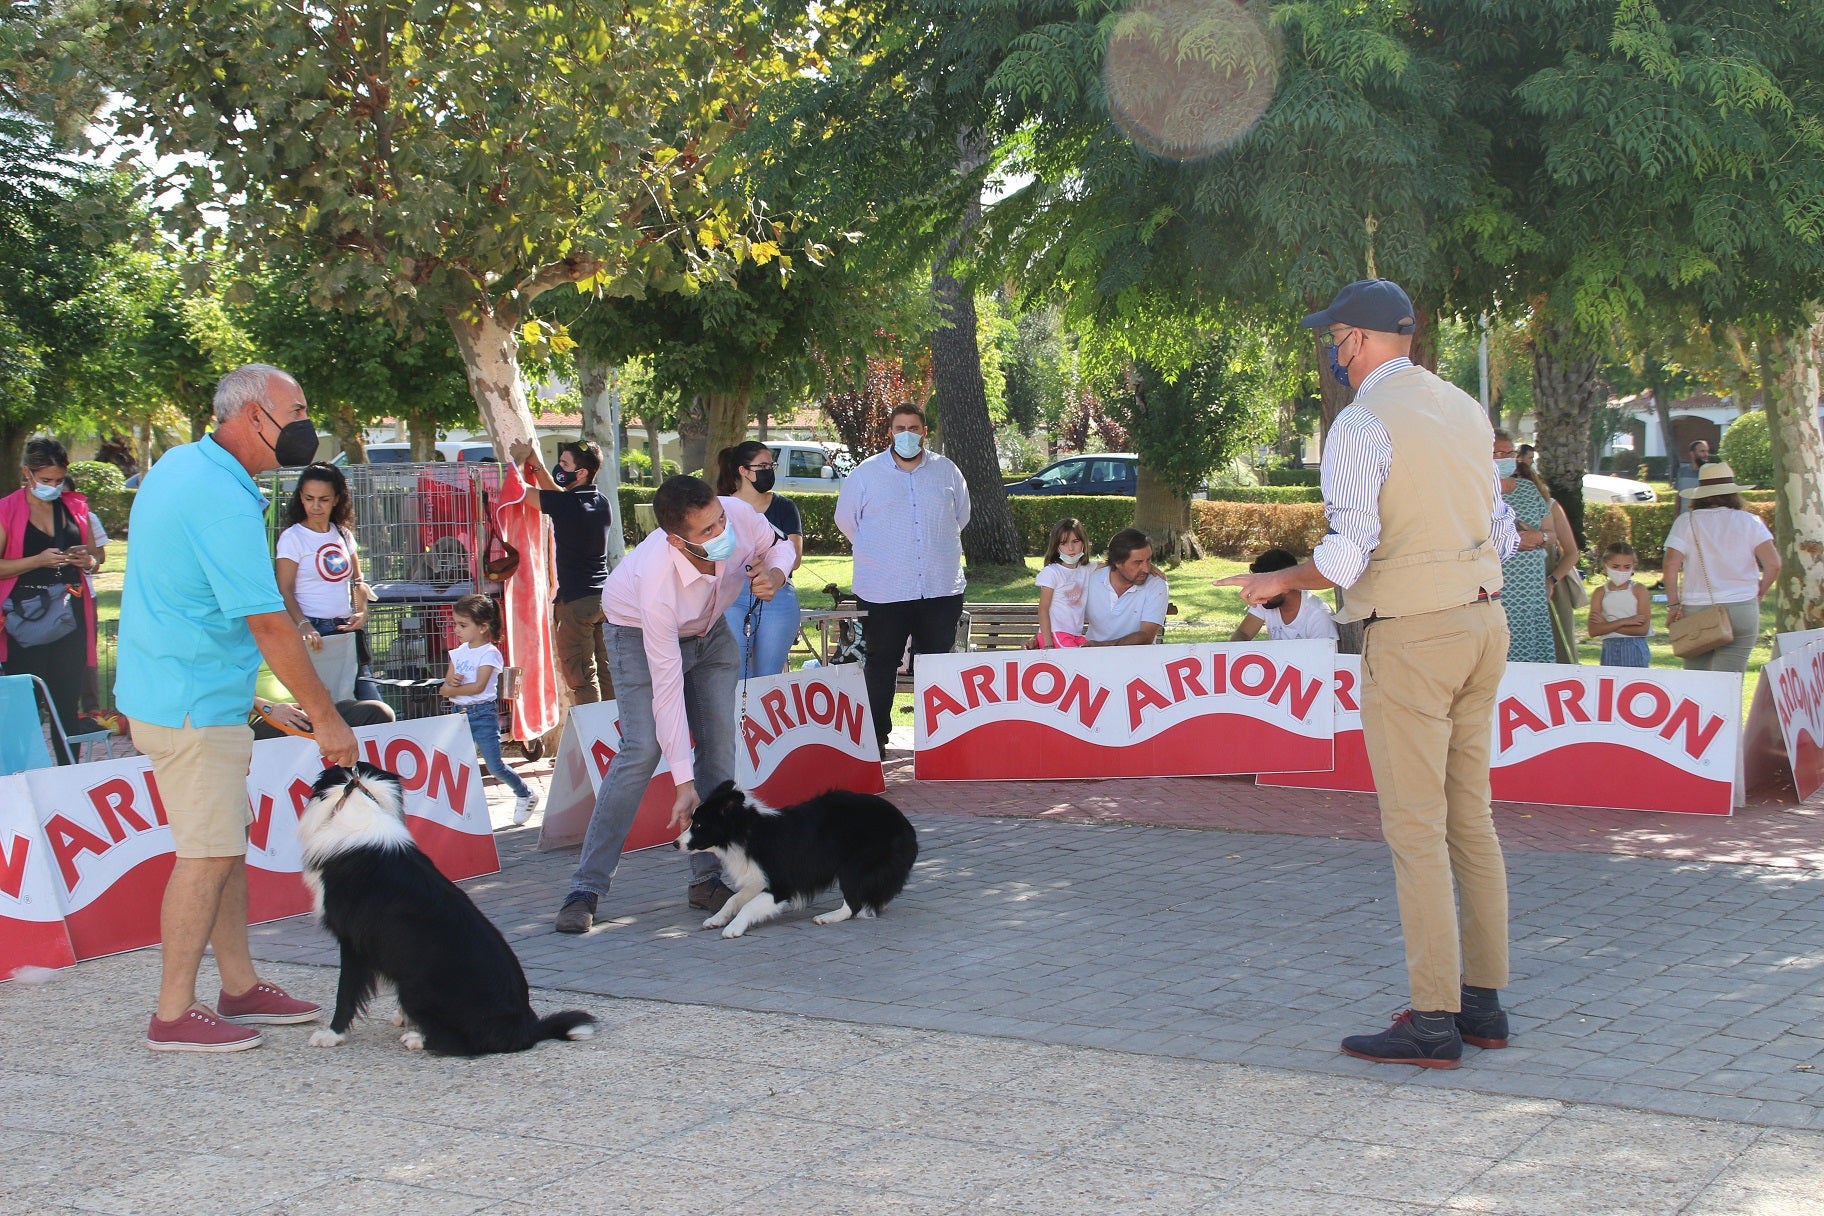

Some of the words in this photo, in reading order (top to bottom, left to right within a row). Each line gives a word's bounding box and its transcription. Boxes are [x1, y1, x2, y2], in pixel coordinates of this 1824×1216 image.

[741, 681, 864, 771] ARION
[923, 661, 1111, 738] ARION
[1126, 653, 1323, 732] ARION
[1498, 678, 1724, 760] ARION
[1777, 667, 1814, 750] ARION
[44, 755, 274, 894] ARIN
